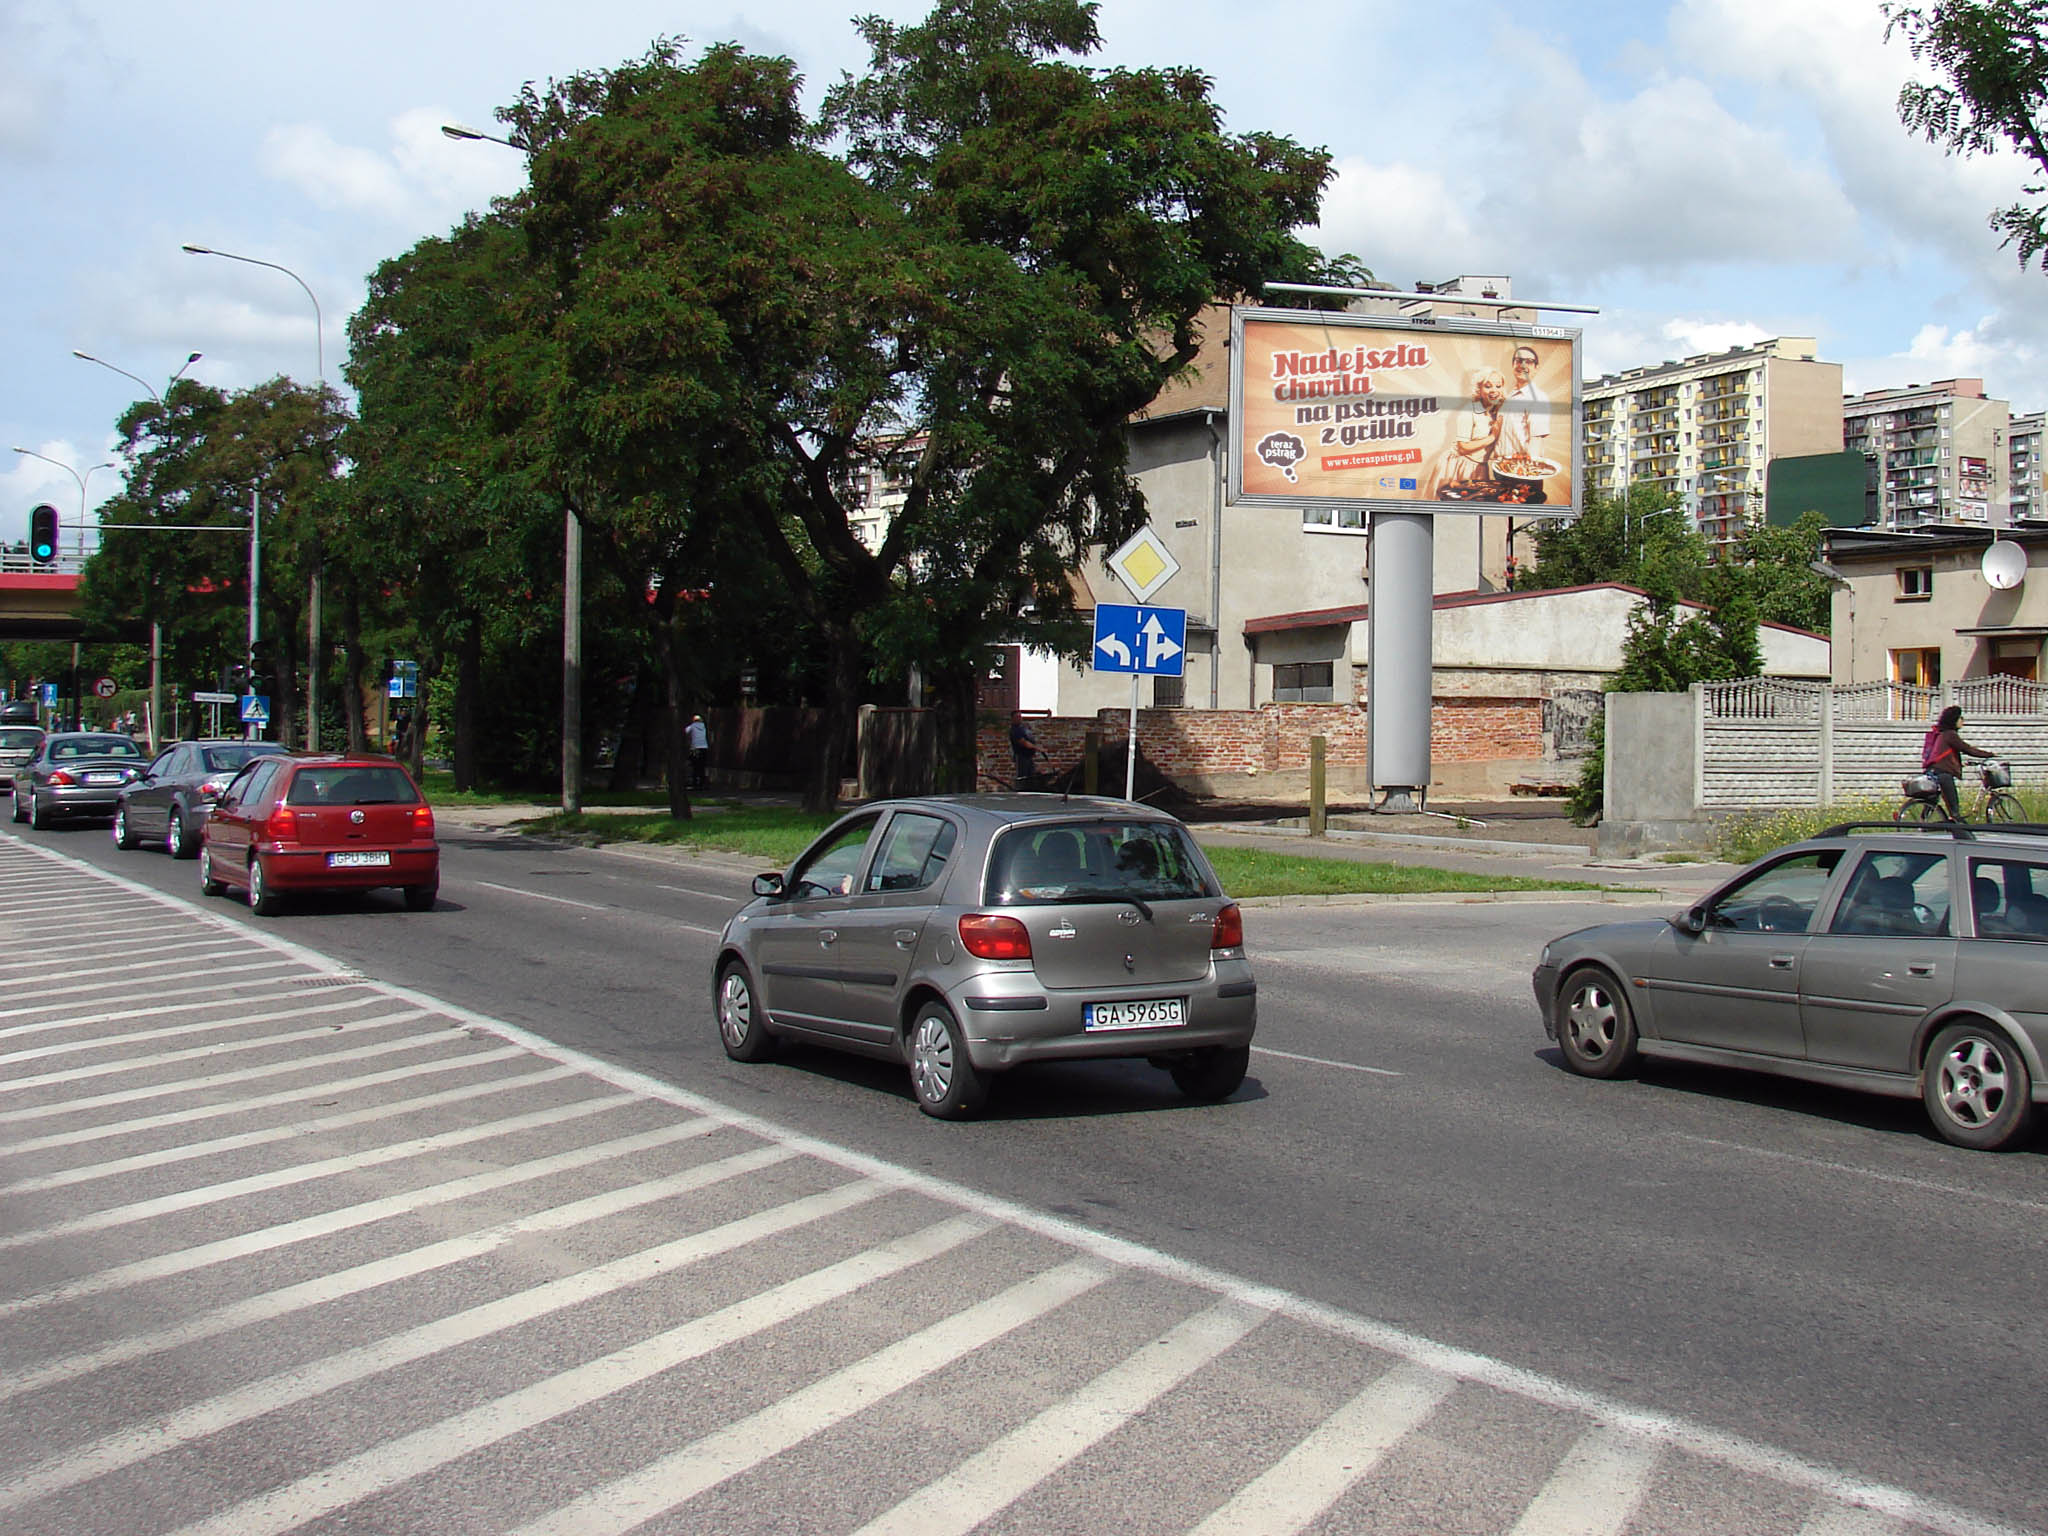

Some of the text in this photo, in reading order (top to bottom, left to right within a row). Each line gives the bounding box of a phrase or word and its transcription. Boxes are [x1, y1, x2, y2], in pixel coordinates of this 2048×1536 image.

[1273, 344, 1430, 377] Nadejszła
[1274, 374, 1373, 401] chwila
[1296, 404, 1332, 423] na
[1321, 418, 1415, 445] z grilla
[1265, 448, 1297, 460] pstrąg
[1270, 440, 1294, 449] teraz
[1326, 450, 1415, 467] www.terazpstrag.pl
